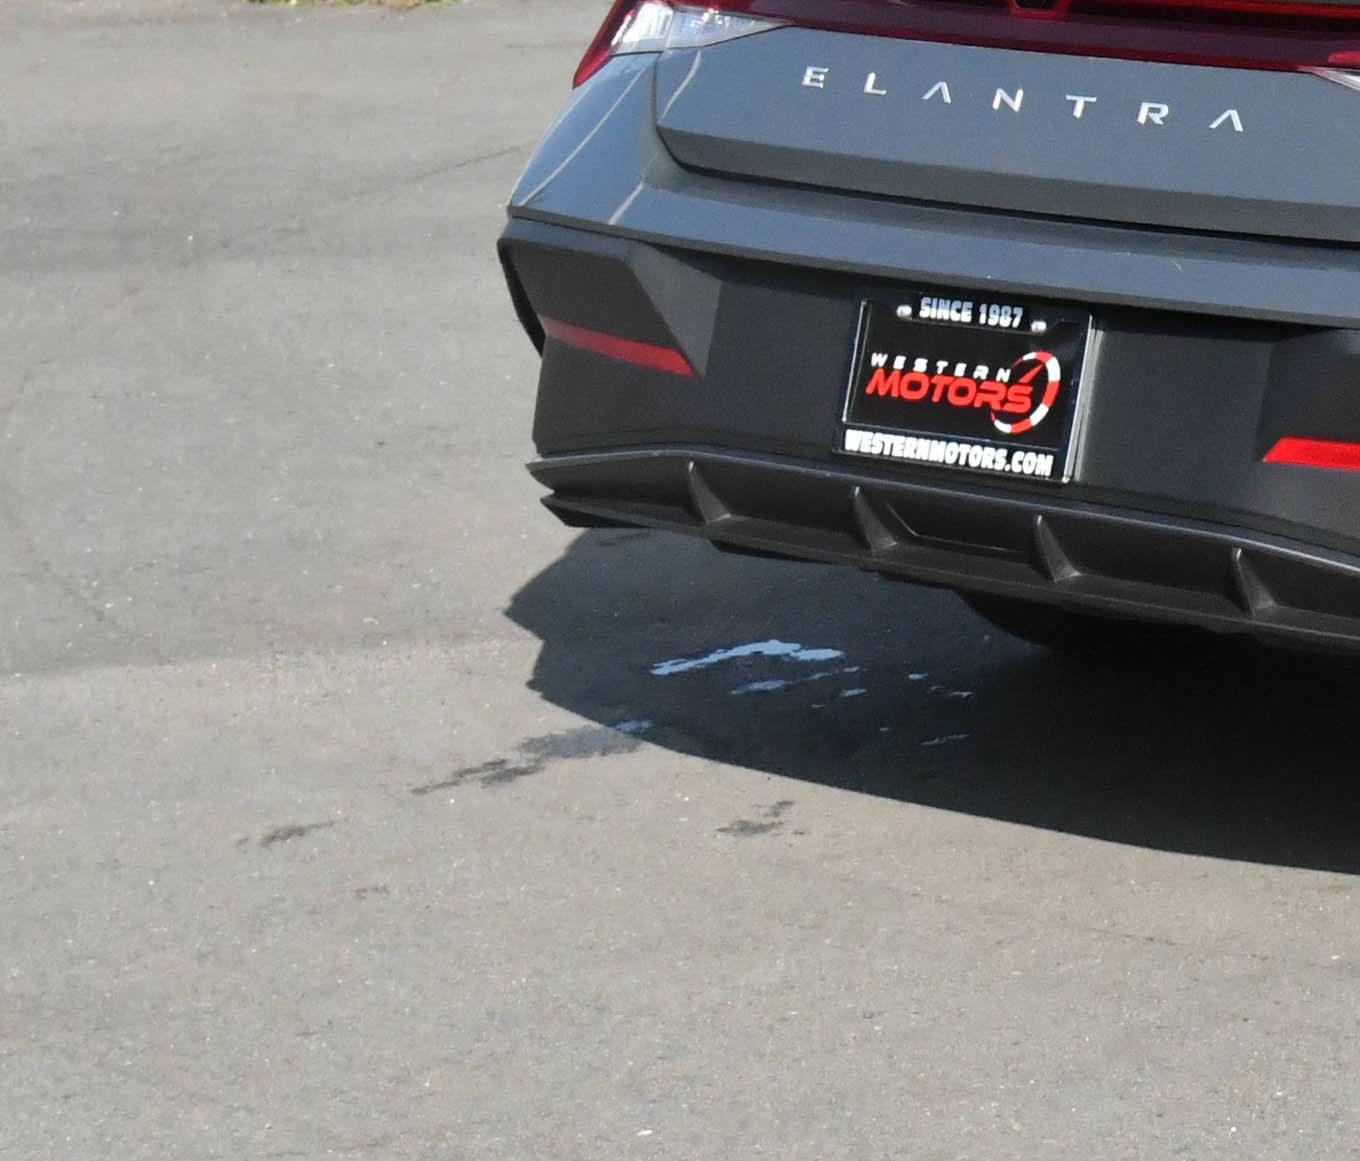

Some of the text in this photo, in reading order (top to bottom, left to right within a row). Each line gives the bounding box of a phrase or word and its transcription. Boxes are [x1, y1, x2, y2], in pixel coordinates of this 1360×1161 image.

[801, 65, 1245, 132] ELANTRA
[919, 297, 1023, 328] SINCE 1987
[871, 352, 1011, 382] WESTERN
[866, 368, 1033, 413] MOTORS
[844, 429, 1054, 477] WESTERNMOTORS.COM
